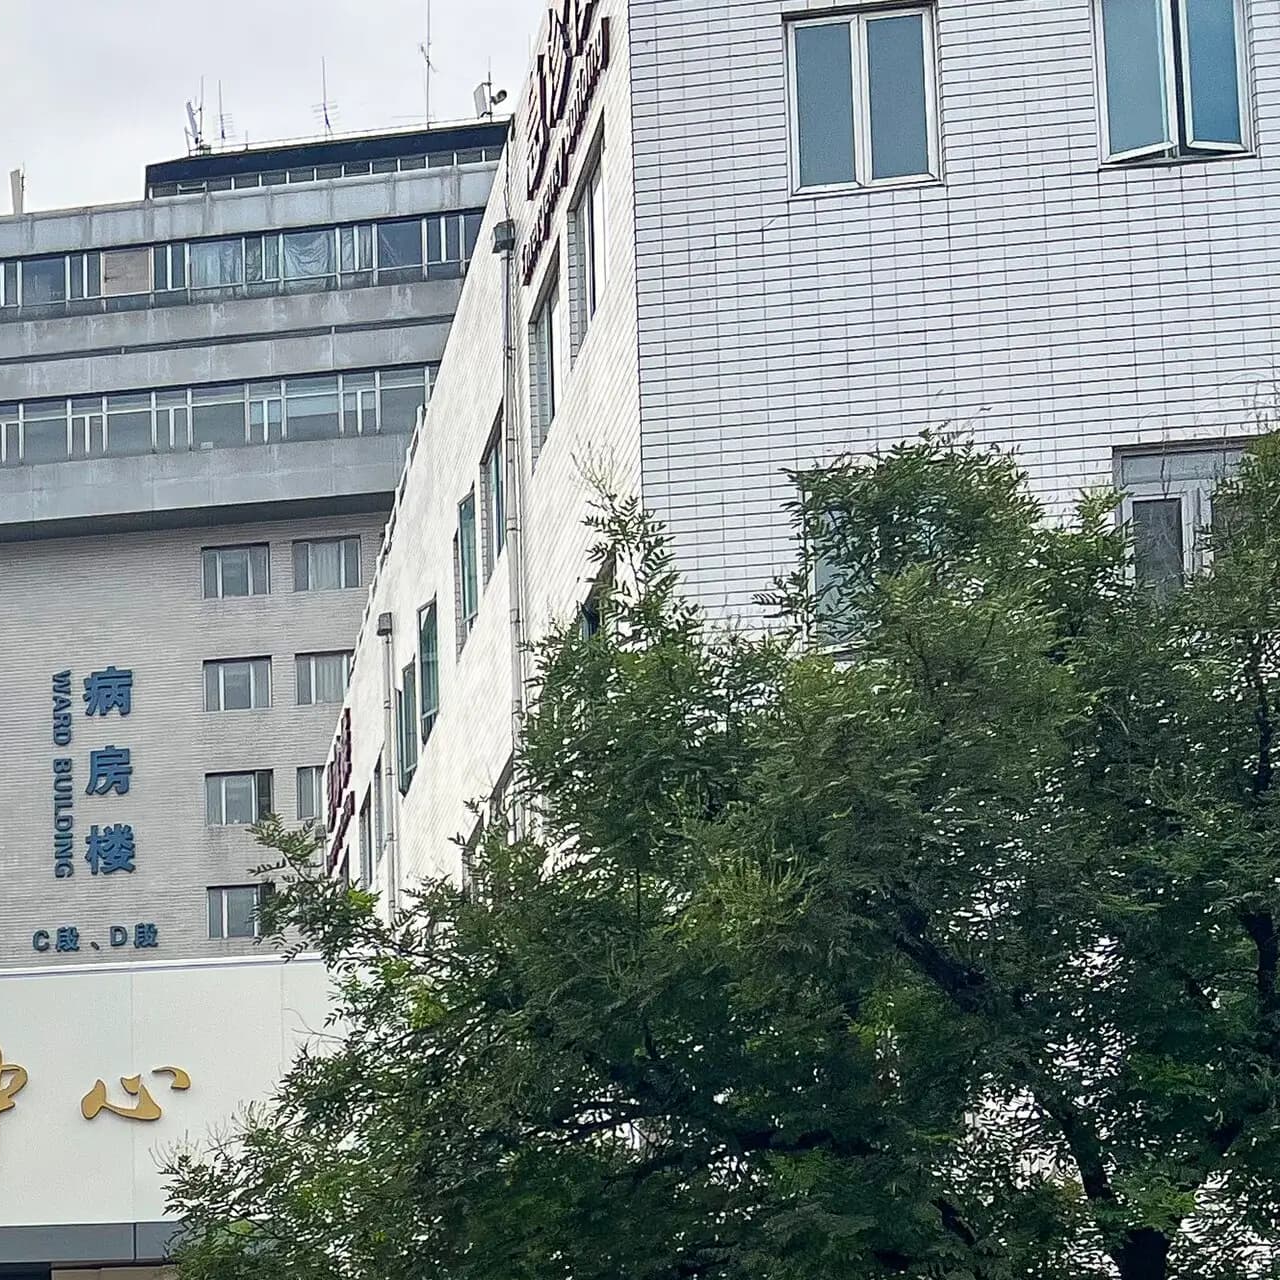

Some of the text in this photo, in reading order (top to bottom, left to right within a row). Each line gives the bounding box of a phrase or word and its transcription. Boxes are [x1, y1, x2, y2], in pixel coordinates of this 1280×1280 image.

[52, 670, 74, 879] WARD BUILDING
[82, 665, 136, 876] 病房楼
